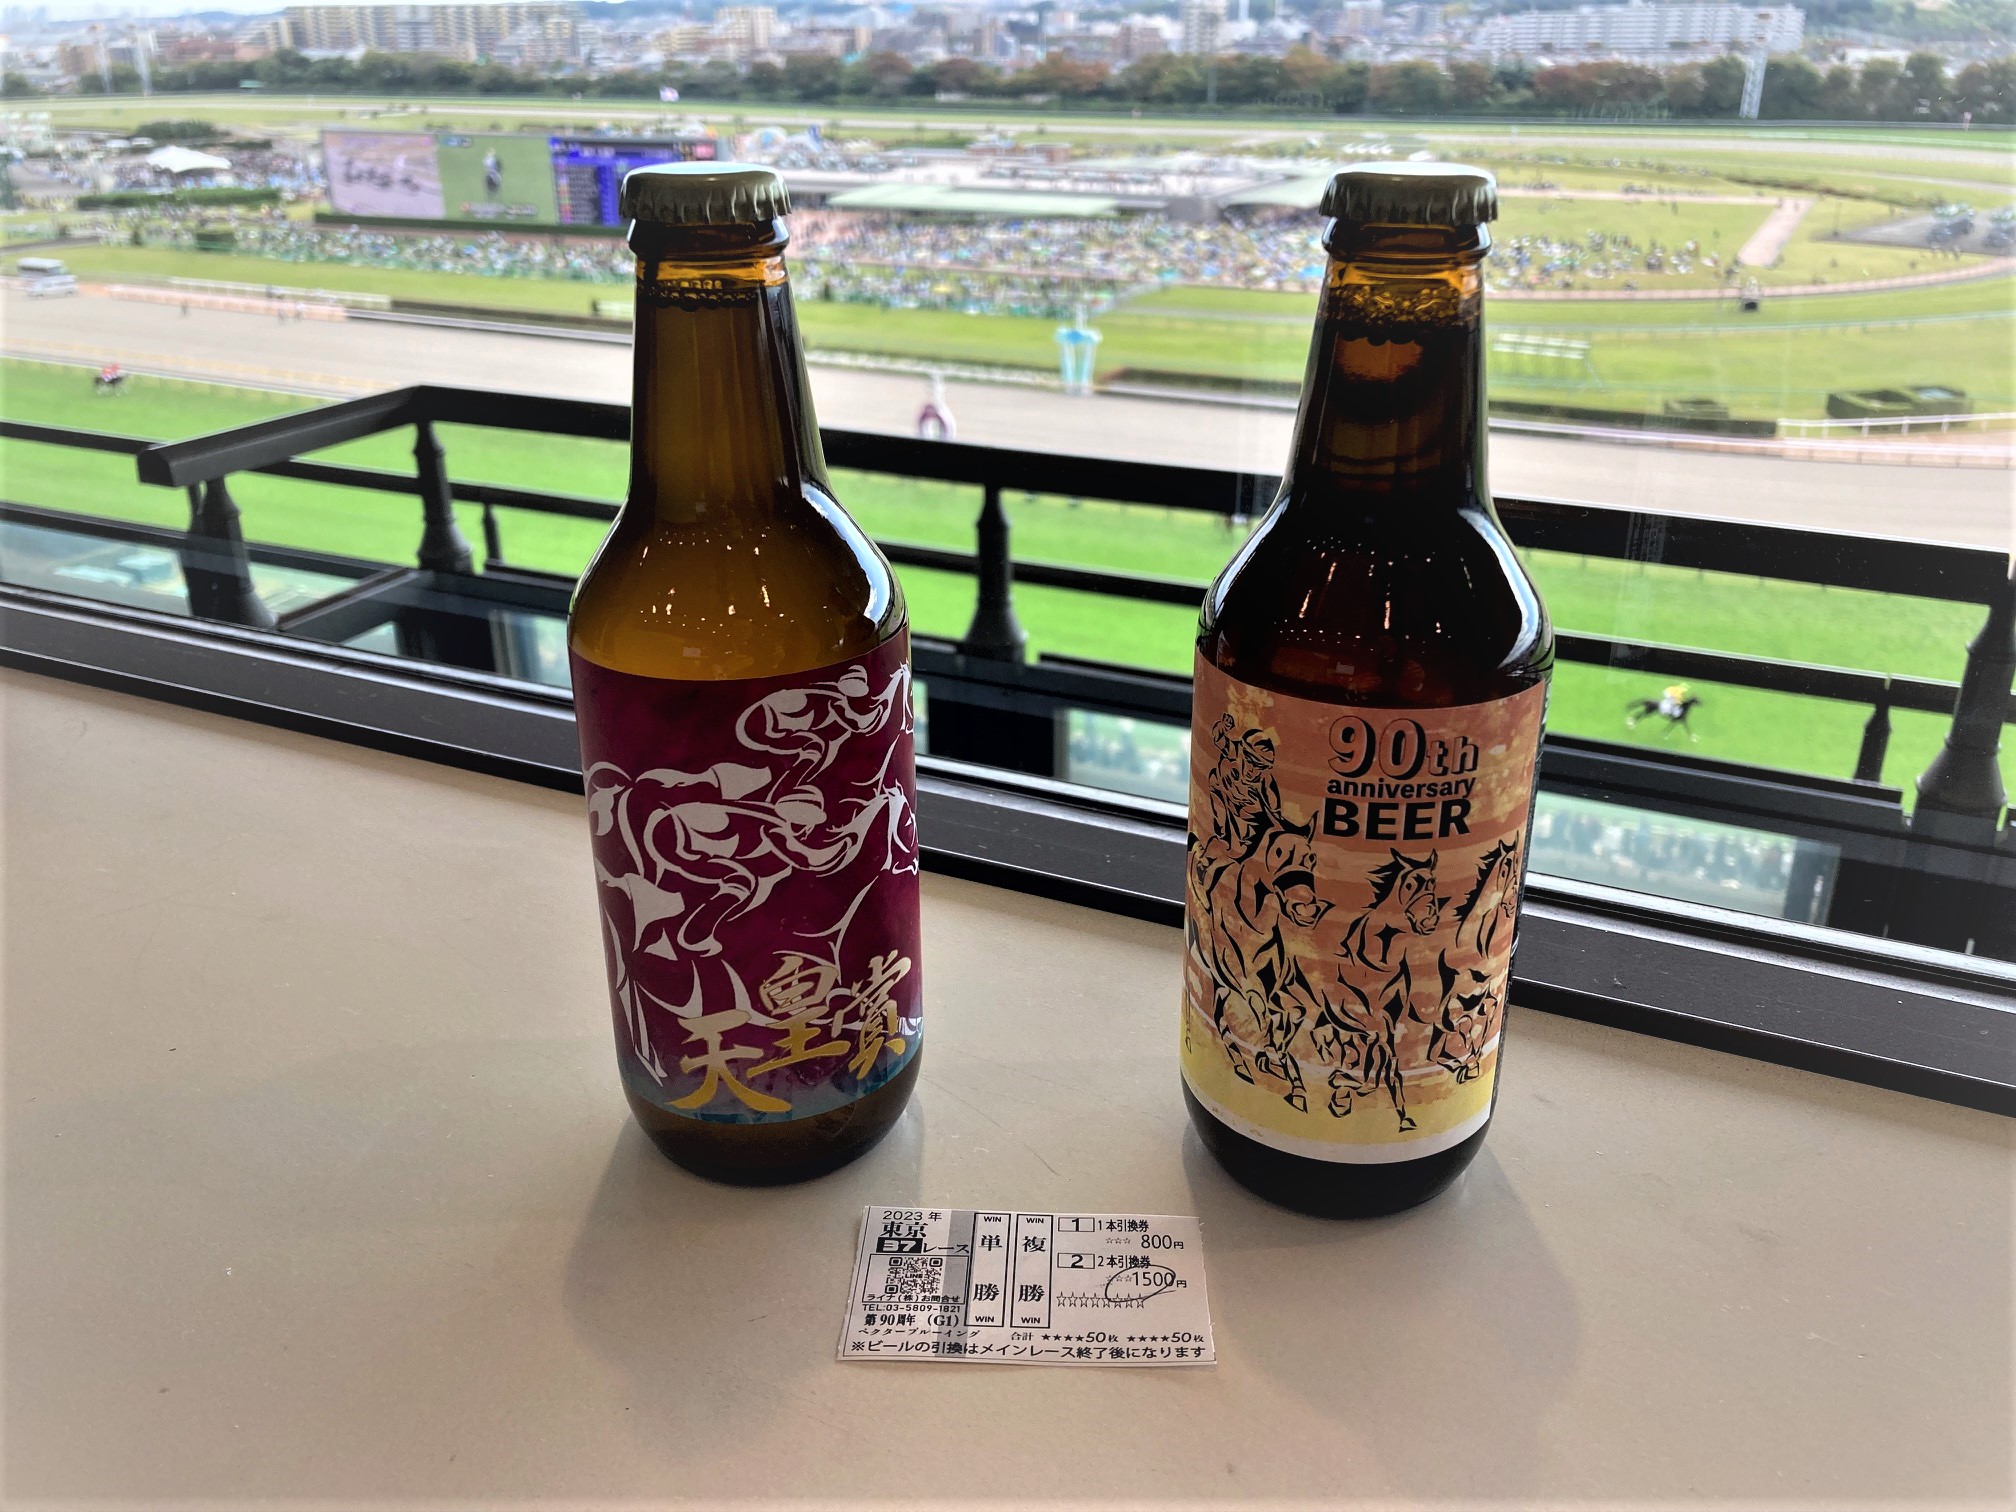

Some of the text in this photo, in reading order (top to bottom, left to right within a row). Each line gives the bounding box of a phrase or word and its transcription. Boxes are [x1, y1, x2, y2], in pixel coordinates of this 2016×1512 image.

[1328, 715, 1479, 780] 90th
[1327, 777, 1476, 799] anniversary
[1323, 797, 1471, 841] BEER
[666, 949, 912, 1112] 天皇賞
[880, 1221, 928, 1238] 東京
[1071, 1218, 1080, 1232] 1
[1071, 1254, 1084, 1269] 2
